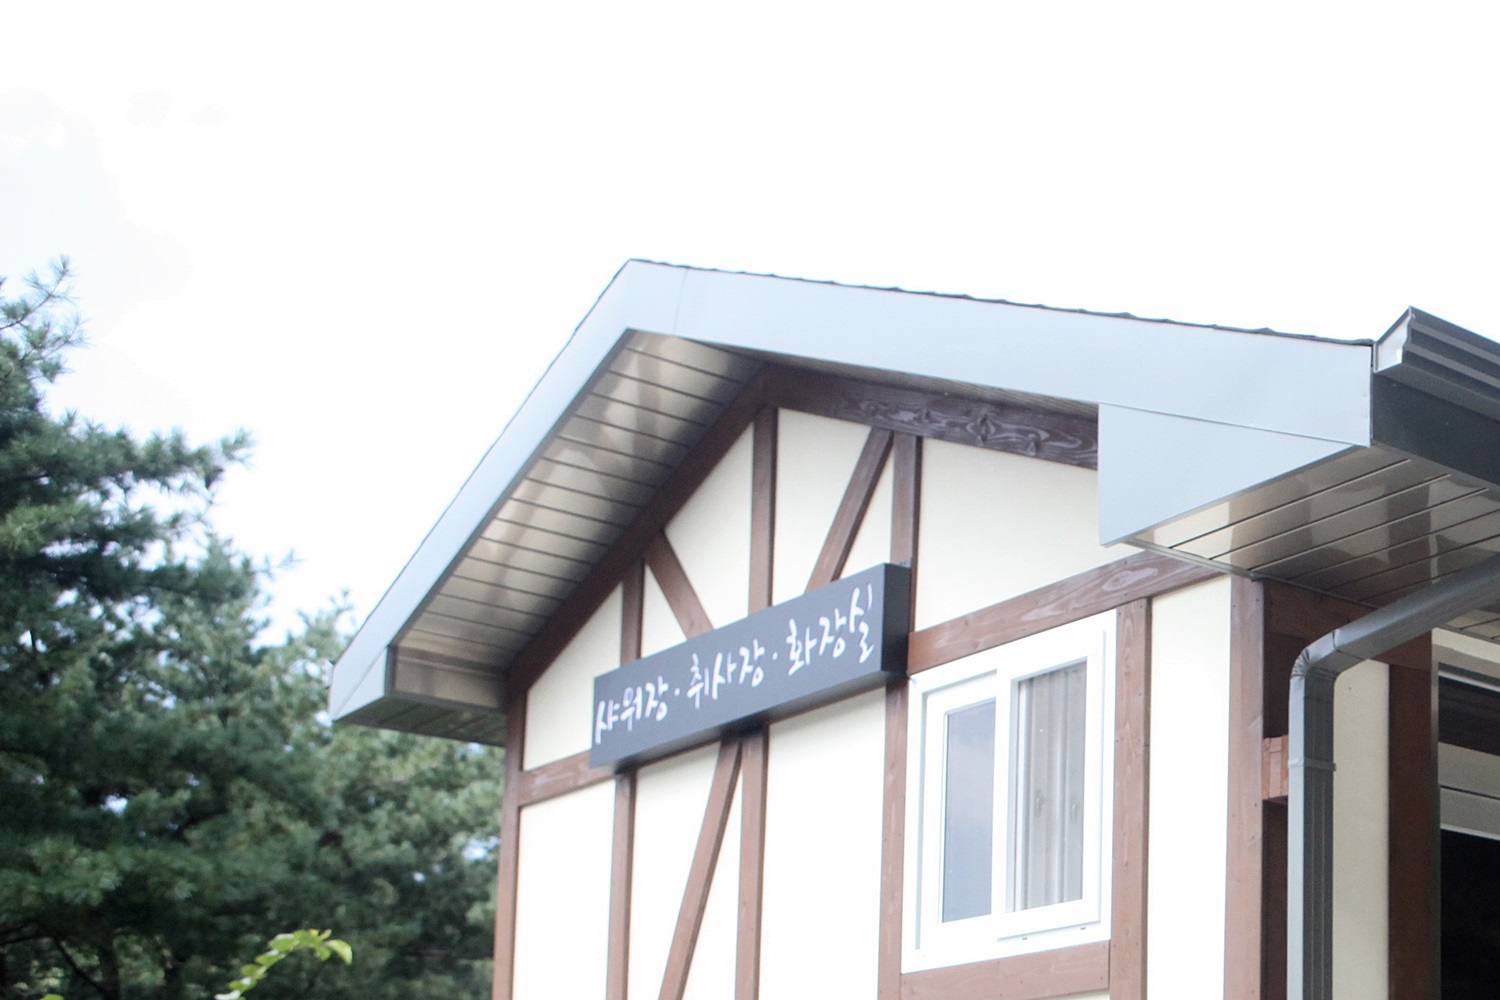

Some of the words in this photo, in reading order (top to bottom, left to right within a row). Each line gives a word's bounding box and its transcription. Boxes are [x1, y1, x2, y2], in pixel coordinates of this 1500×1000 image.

[595, 675, 668, 743] 샤워장
[686, 639, 764, 709] 취사장
[786, 583, 873, 675] 화장실
